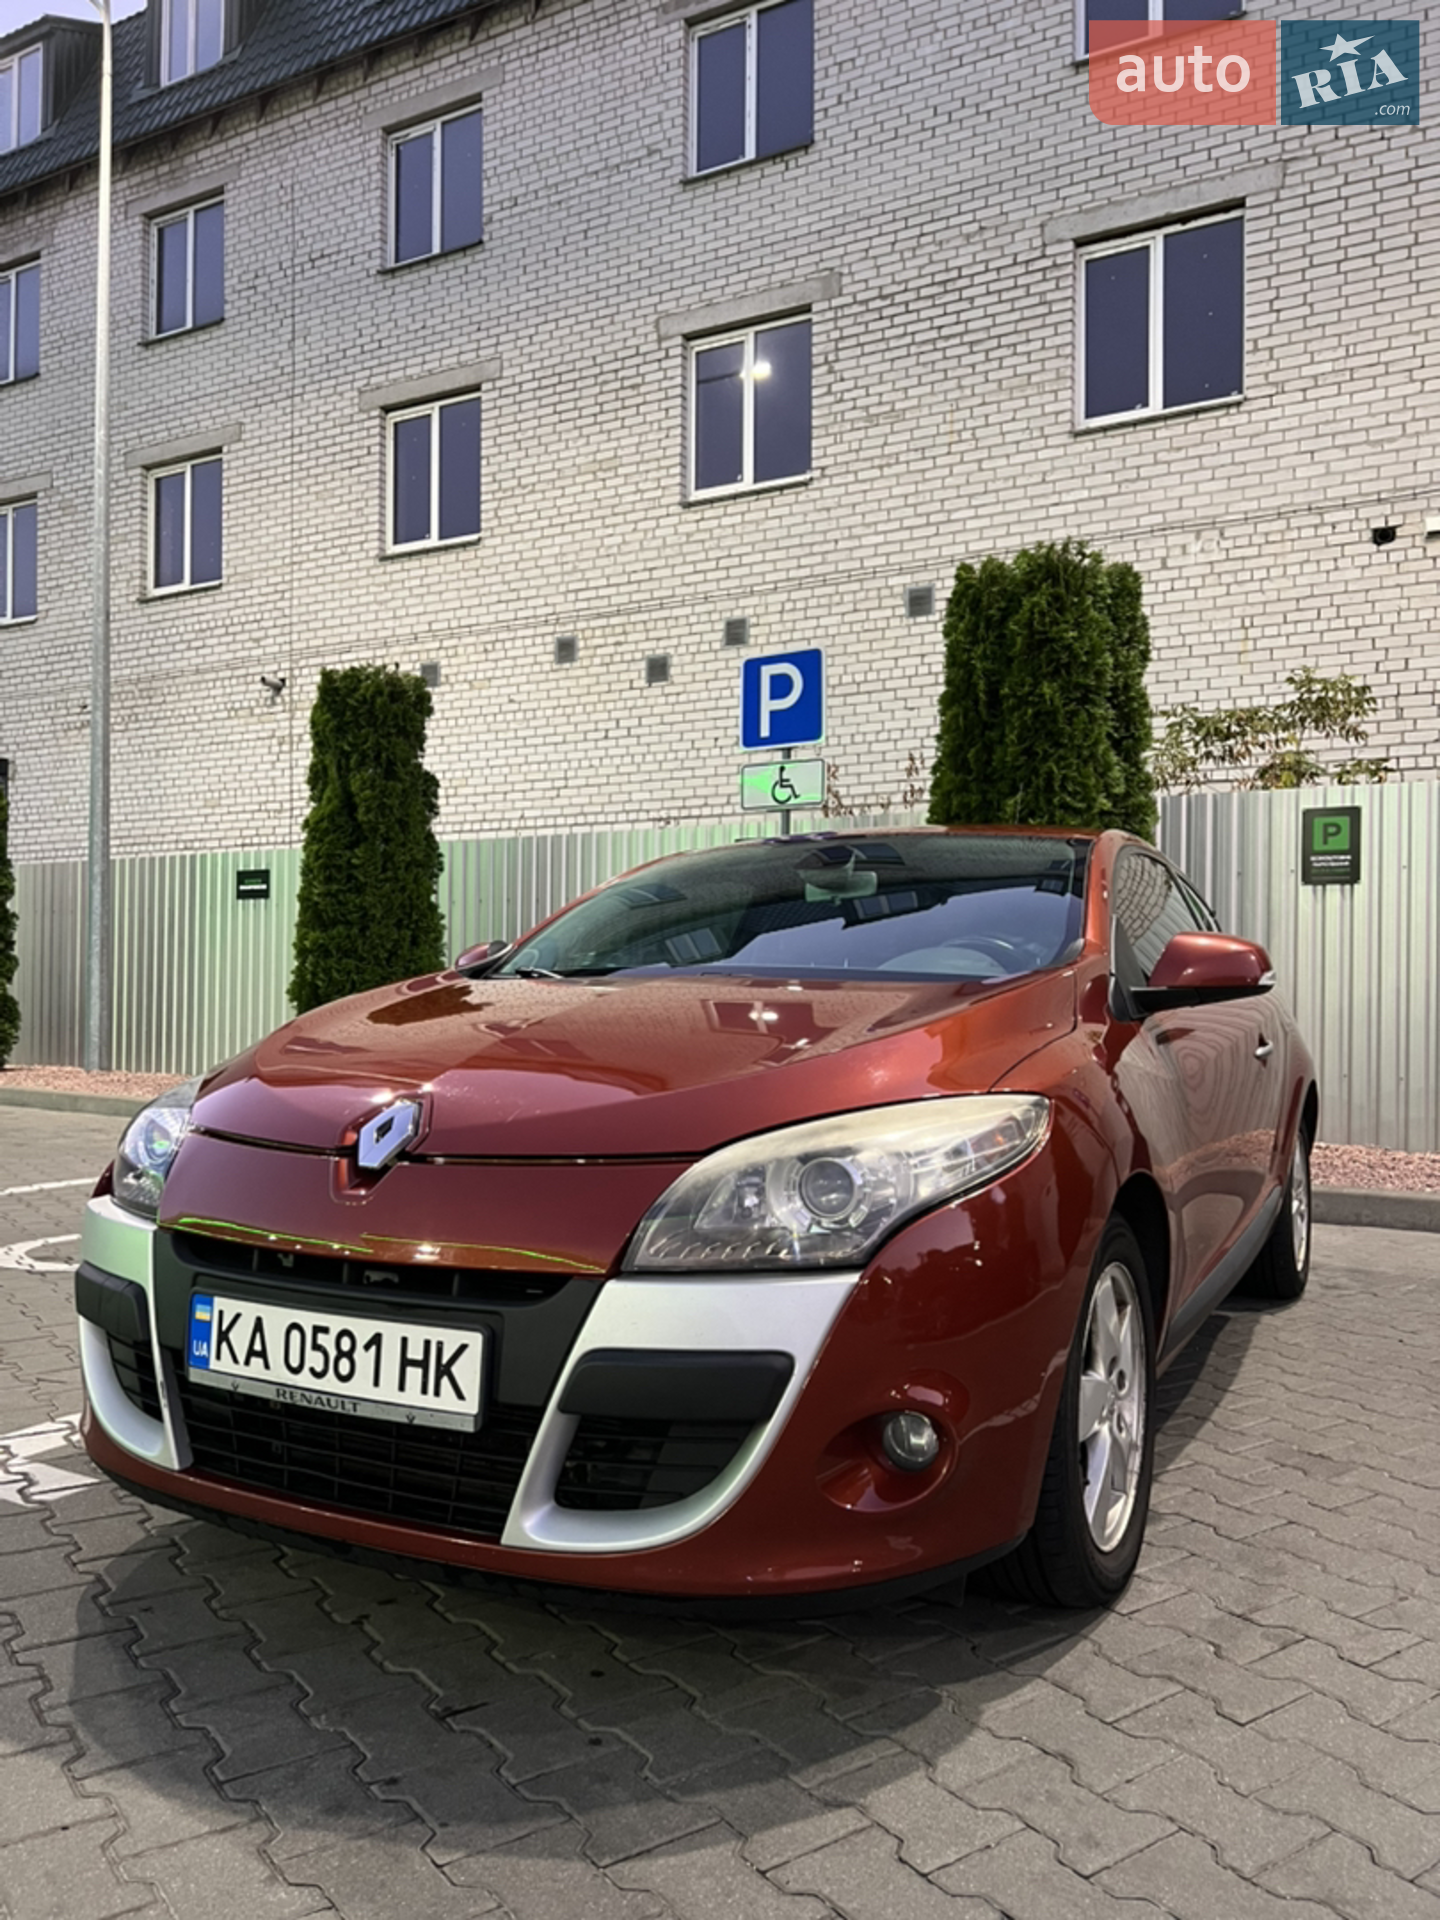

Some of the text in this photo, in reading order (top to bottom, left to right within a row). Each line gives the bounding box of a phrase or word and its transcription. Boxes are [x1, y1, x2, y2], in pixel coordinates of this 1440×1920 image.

[759, 662, 805, 739] P
[1322, 822, 1343, 846] P
[192, 1339, 209, 1358] UA
[214, 1308, 470, 1402] KA 0581 HK
[275, 1387, 361, 1413] RENAULT
